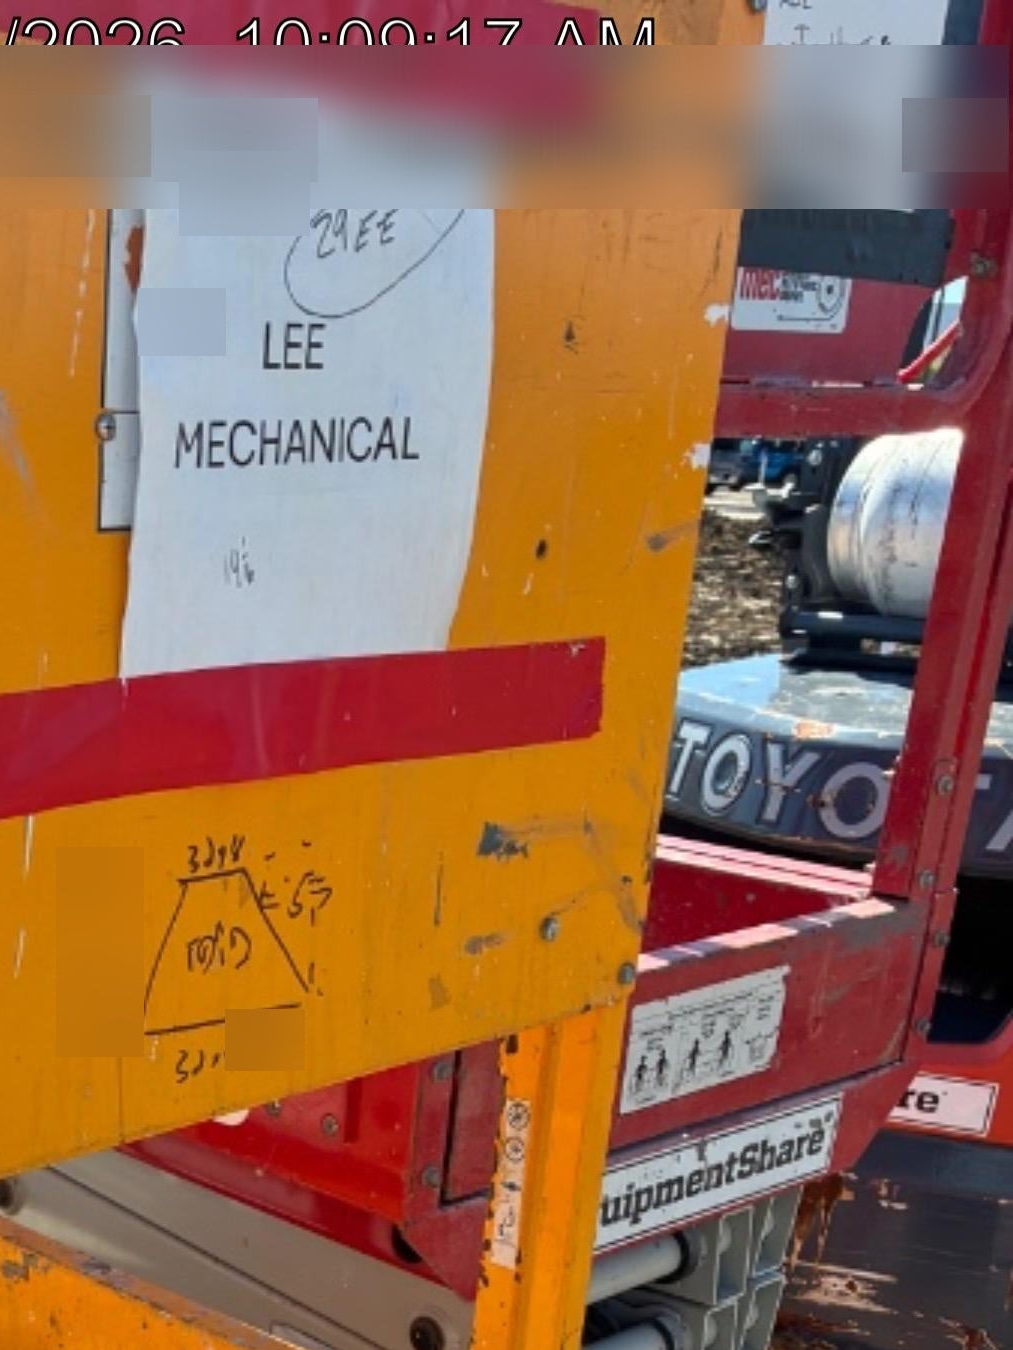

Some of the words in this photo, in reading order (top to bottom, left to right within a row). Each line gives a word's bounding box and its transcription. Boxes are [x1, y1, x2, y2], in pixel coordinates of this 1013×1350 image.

[261, 321, 327, 371] LEE
[174, 416, 420, 469] MECHANICAL
[896, 1089, 940, 1114] re
[600, 1128, 826, 1226] uipmentShare
